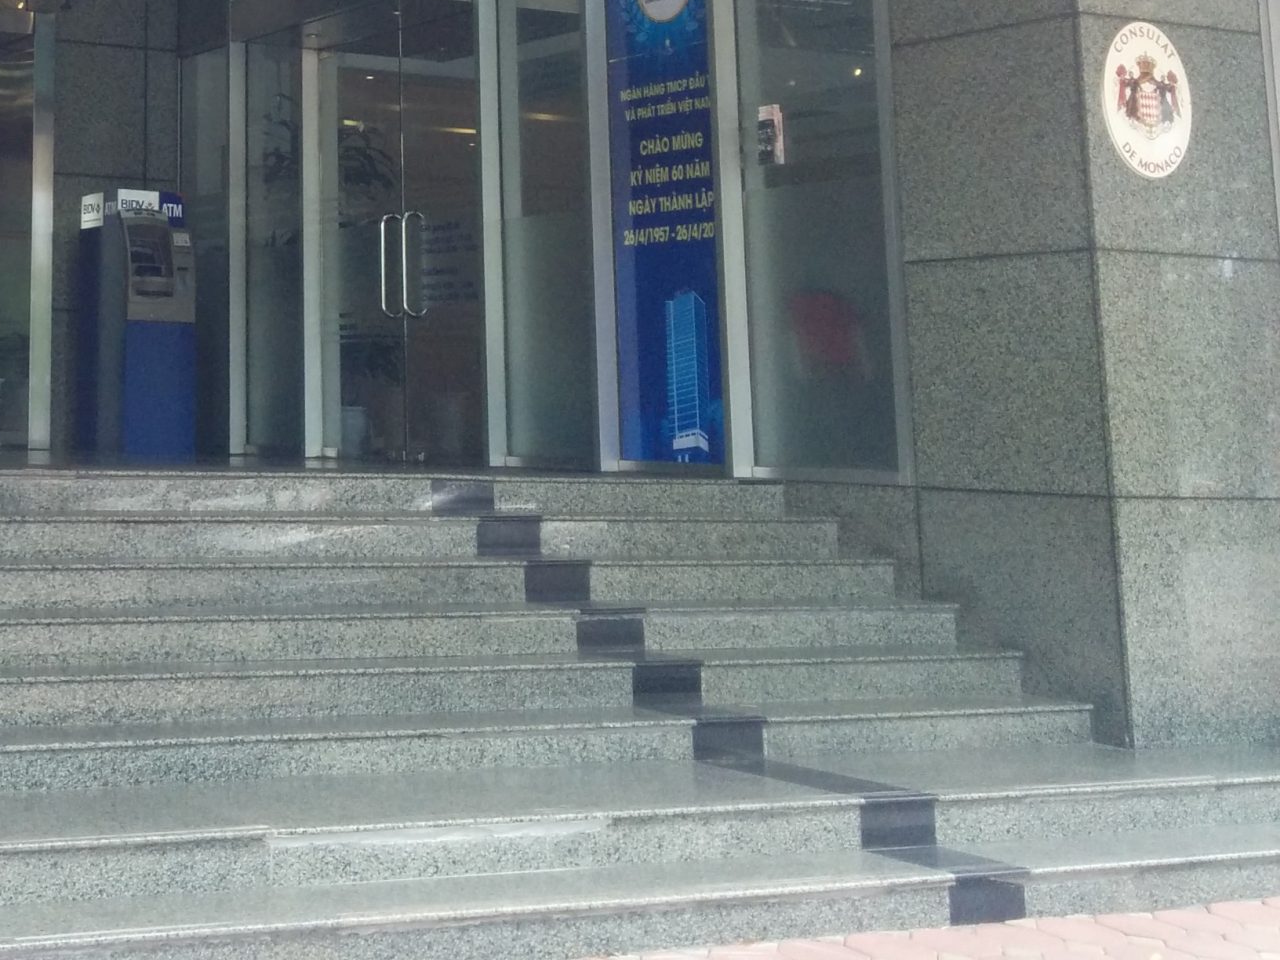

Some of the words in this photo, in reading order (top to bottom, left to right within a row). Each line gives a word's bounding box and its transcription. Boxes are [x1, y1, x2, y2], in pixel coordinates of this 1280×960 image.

[1114, 25, 1176, 60] CONSULAT
[640, 134, 669, 155] CHÀO
[672, 130, 704, 151] MỪNG
[1122, 141, 1138, 162] DE
[1137, 145, 1183, 174] MONACO
[645, 163, 670, 187] NIỆM
[671, 164, 684, 181] 60
[686, 158, 710, 179] NĂM
[82, 203, 96, 215] BIDV
[120, 198, 145, 209] BIDV
[161, 203, 183, 218] ATM
[628, 195, 656, 216] NGÀY
[658, 191, 693, 212] THÀNH
[695, 187, 714, 212] LẬP
